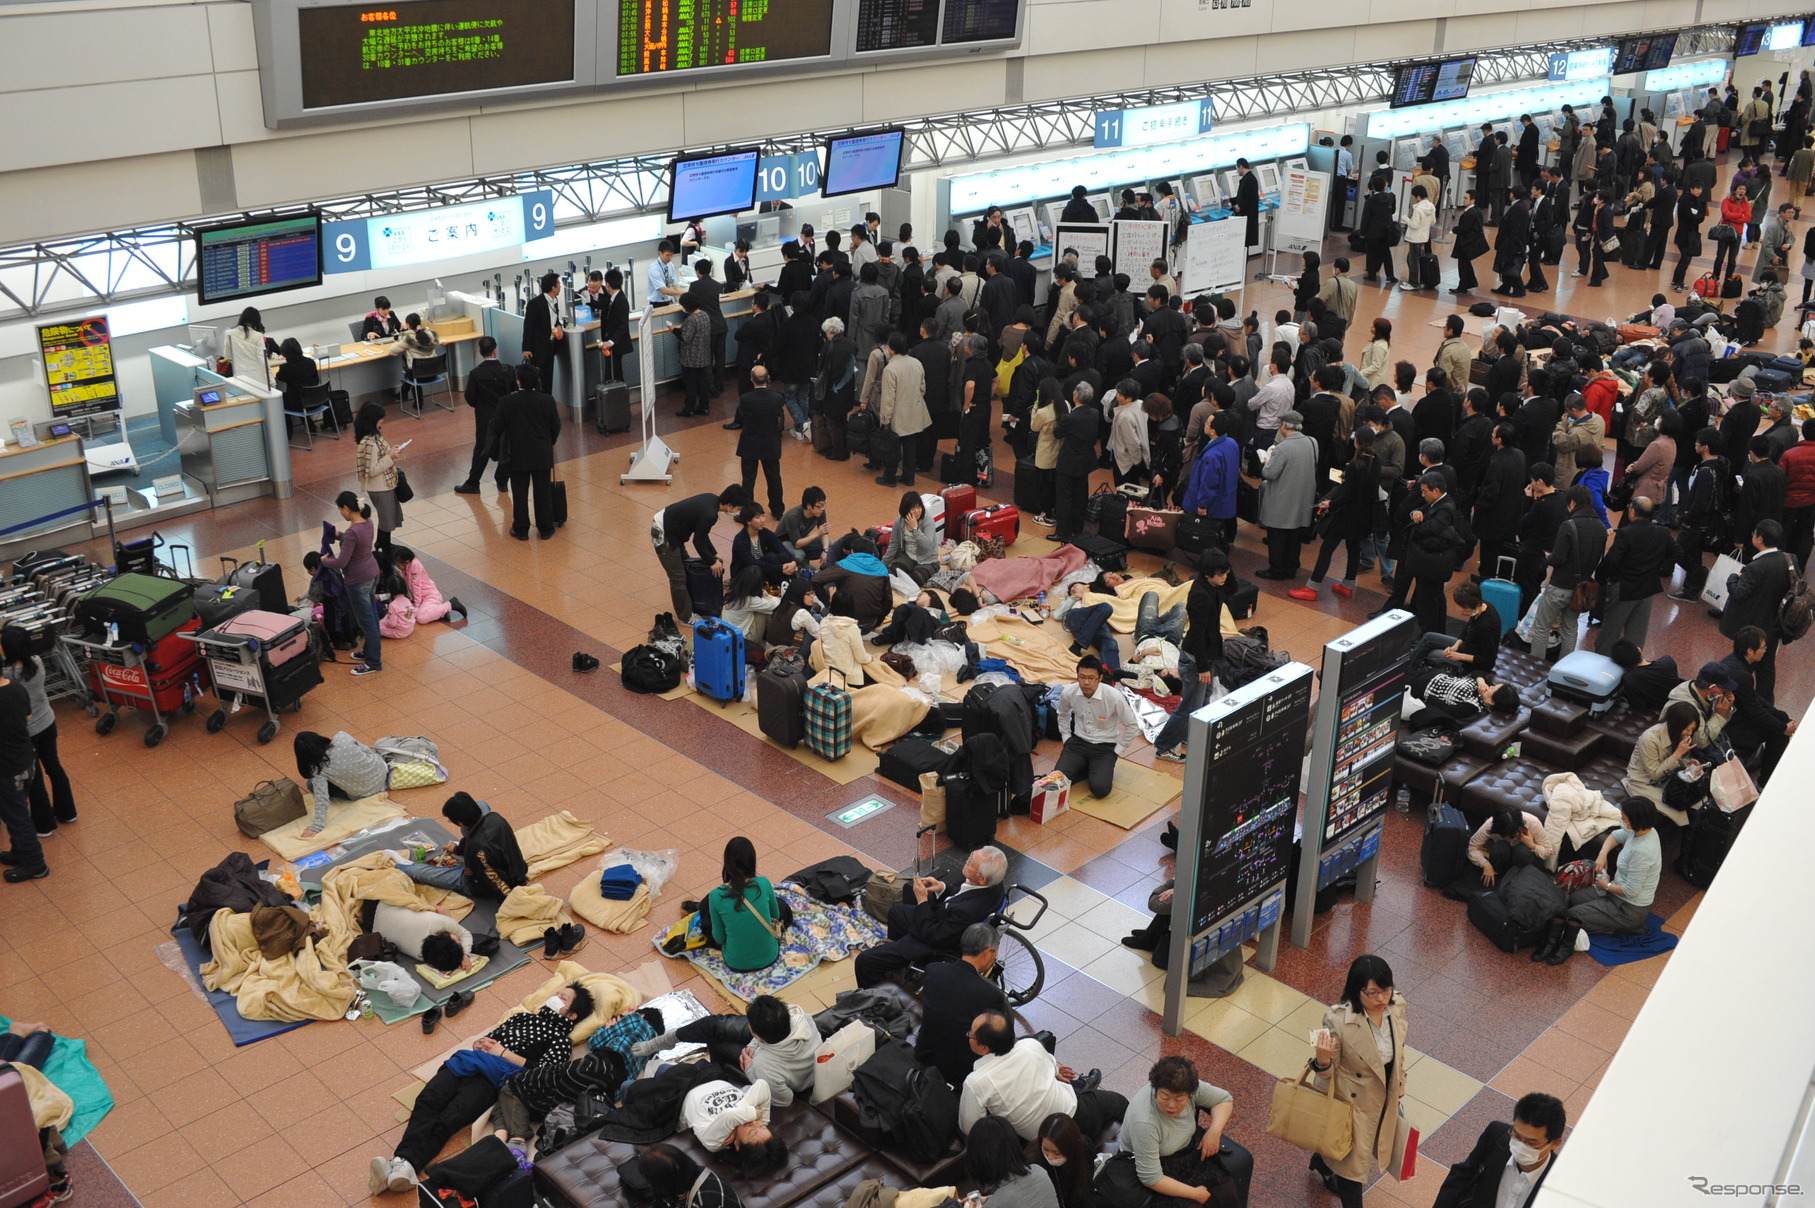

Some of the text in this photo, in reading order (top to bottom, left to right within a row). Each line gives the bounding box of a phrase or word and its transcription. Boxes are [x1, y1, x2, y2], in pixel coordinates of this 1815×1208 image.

[361, 11, 397, 21] お客様各位
[1553, 60, 1567, 75] 12
[1202, 106, 1211, 126] 11
[1102, 119, 1119, 140] 11
[758, 166, 786, 192] 10
[798, 162, 815, 187] 10
[532, 203, 546, 230] 9
[428, 223, 478, 242] ご案内
[335, 233, 357, 262] 9
[42, 324, 92, 337] 危険物について
[158, 482, 179, 490] CLOSED
[105, 665, 140, 682] Coca-Cola
